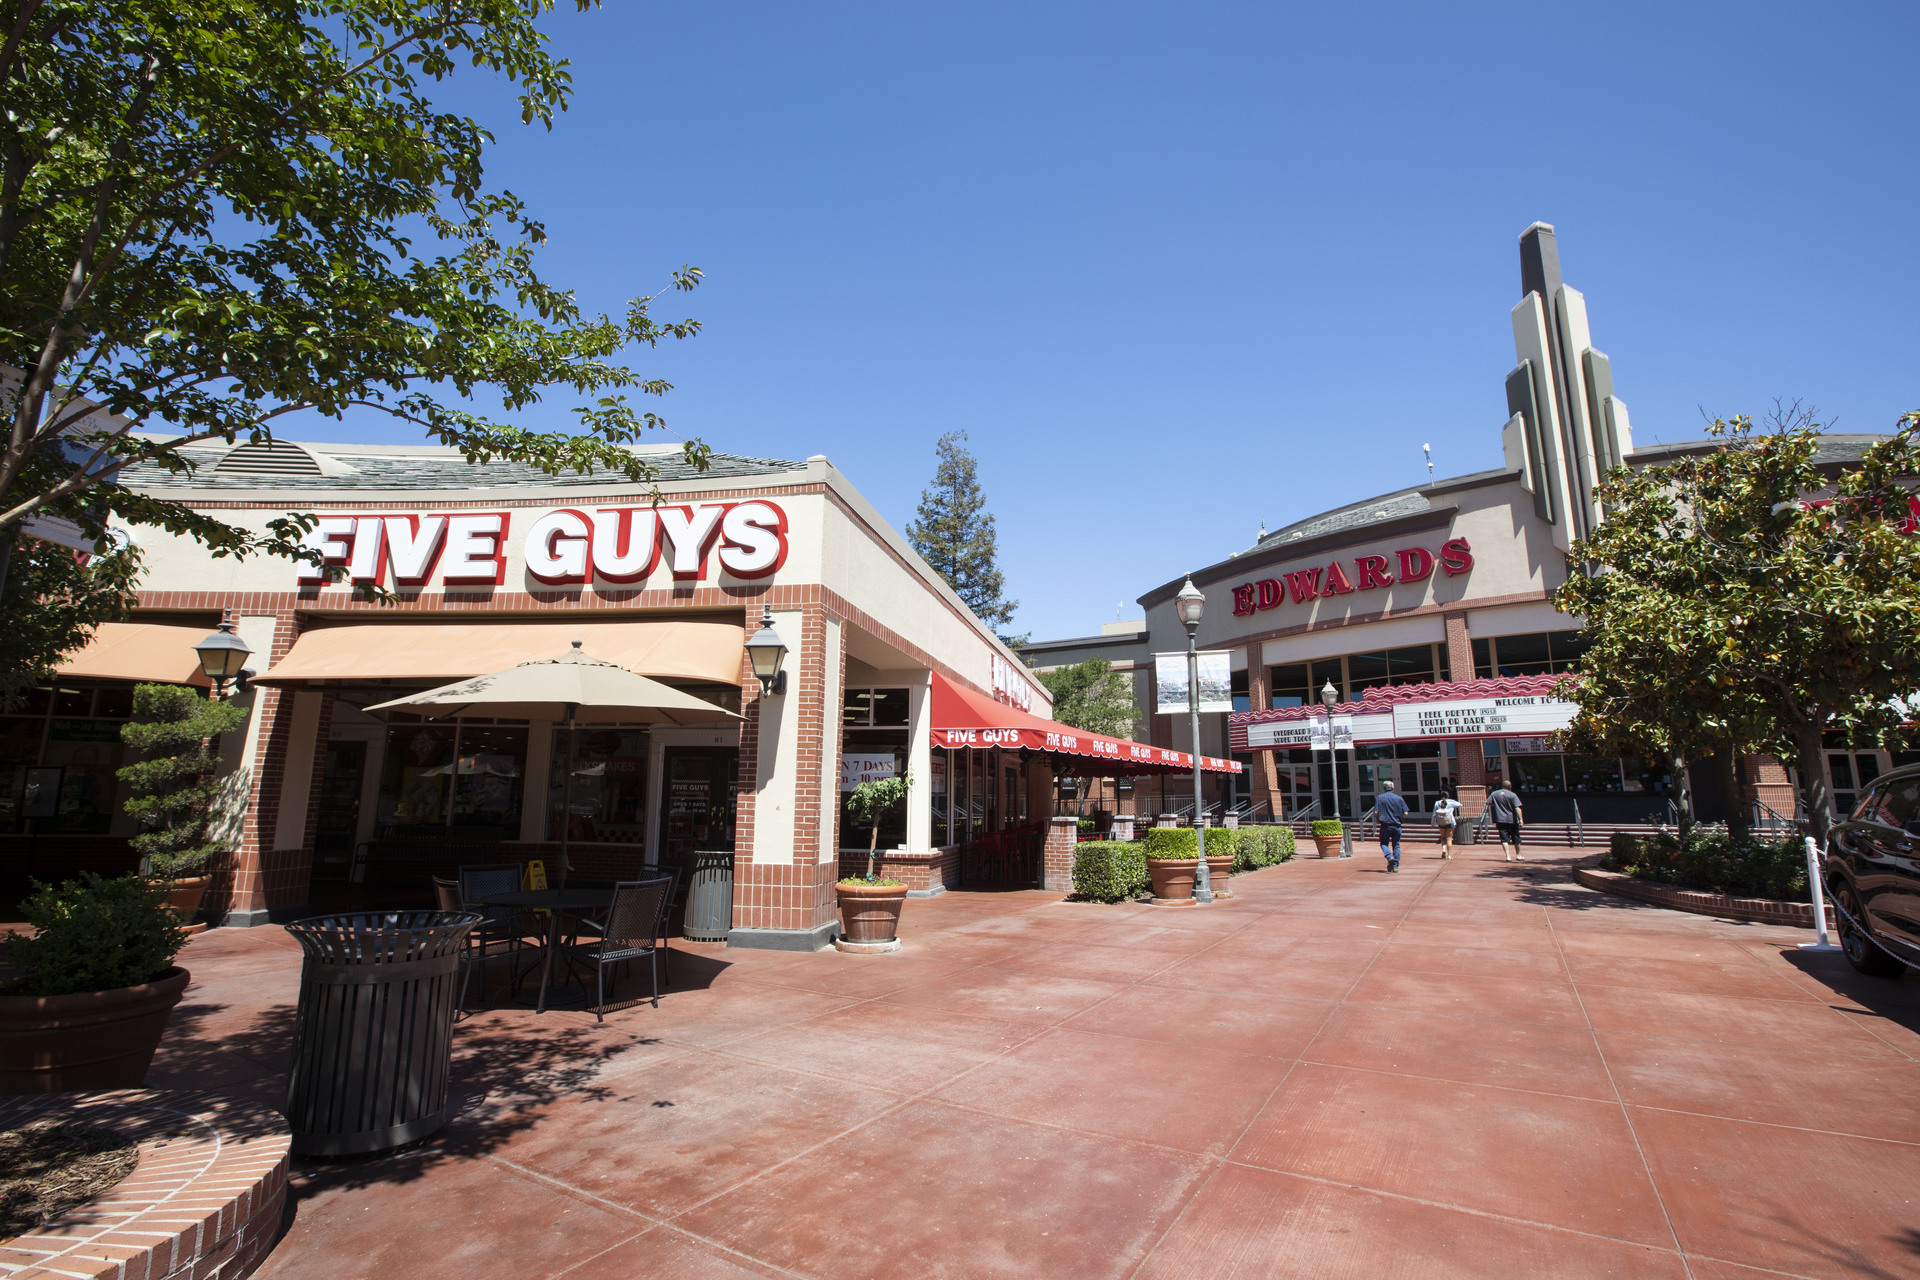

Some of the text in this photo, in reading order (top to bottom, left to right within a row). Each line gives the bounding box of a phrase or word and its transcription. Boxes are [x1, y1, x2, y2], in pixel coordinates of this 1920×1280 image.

[297, 500, 788, 586] FIVE GUYS
[1232, 537, 1475, 616] EDWARDS
[1495, 697, 1536, 706] WELCOME
[1540, 696, 1553, 704] TO
[1446, 709, 1477, 717] PRETTY
[1420, 719, 1445, 727] TRUTH
[1464, 716, 1485, 724] DARE
[1273, 729, 1307, 737] OVERBOARD
[1420, 727, 1426, 735] A
[1429, 726, 1452, 734] QUIET
[1456, 725, 1481, 733] PLACE
[947, 729, 1018, 743] FIVE GUYS
[1046, 733, 1077, 749] FIVE GUYS
[1274, 736, 1290, 744] SUPER
[1093, 740, 1118, 754] FIVE GUYS
[1130, 746, 1151, 759] FIVE GUYS
[854, 761, 860, 771] 7
[864, 761, 893, 771] DAYS
[861, 773, 871, 783] 10
